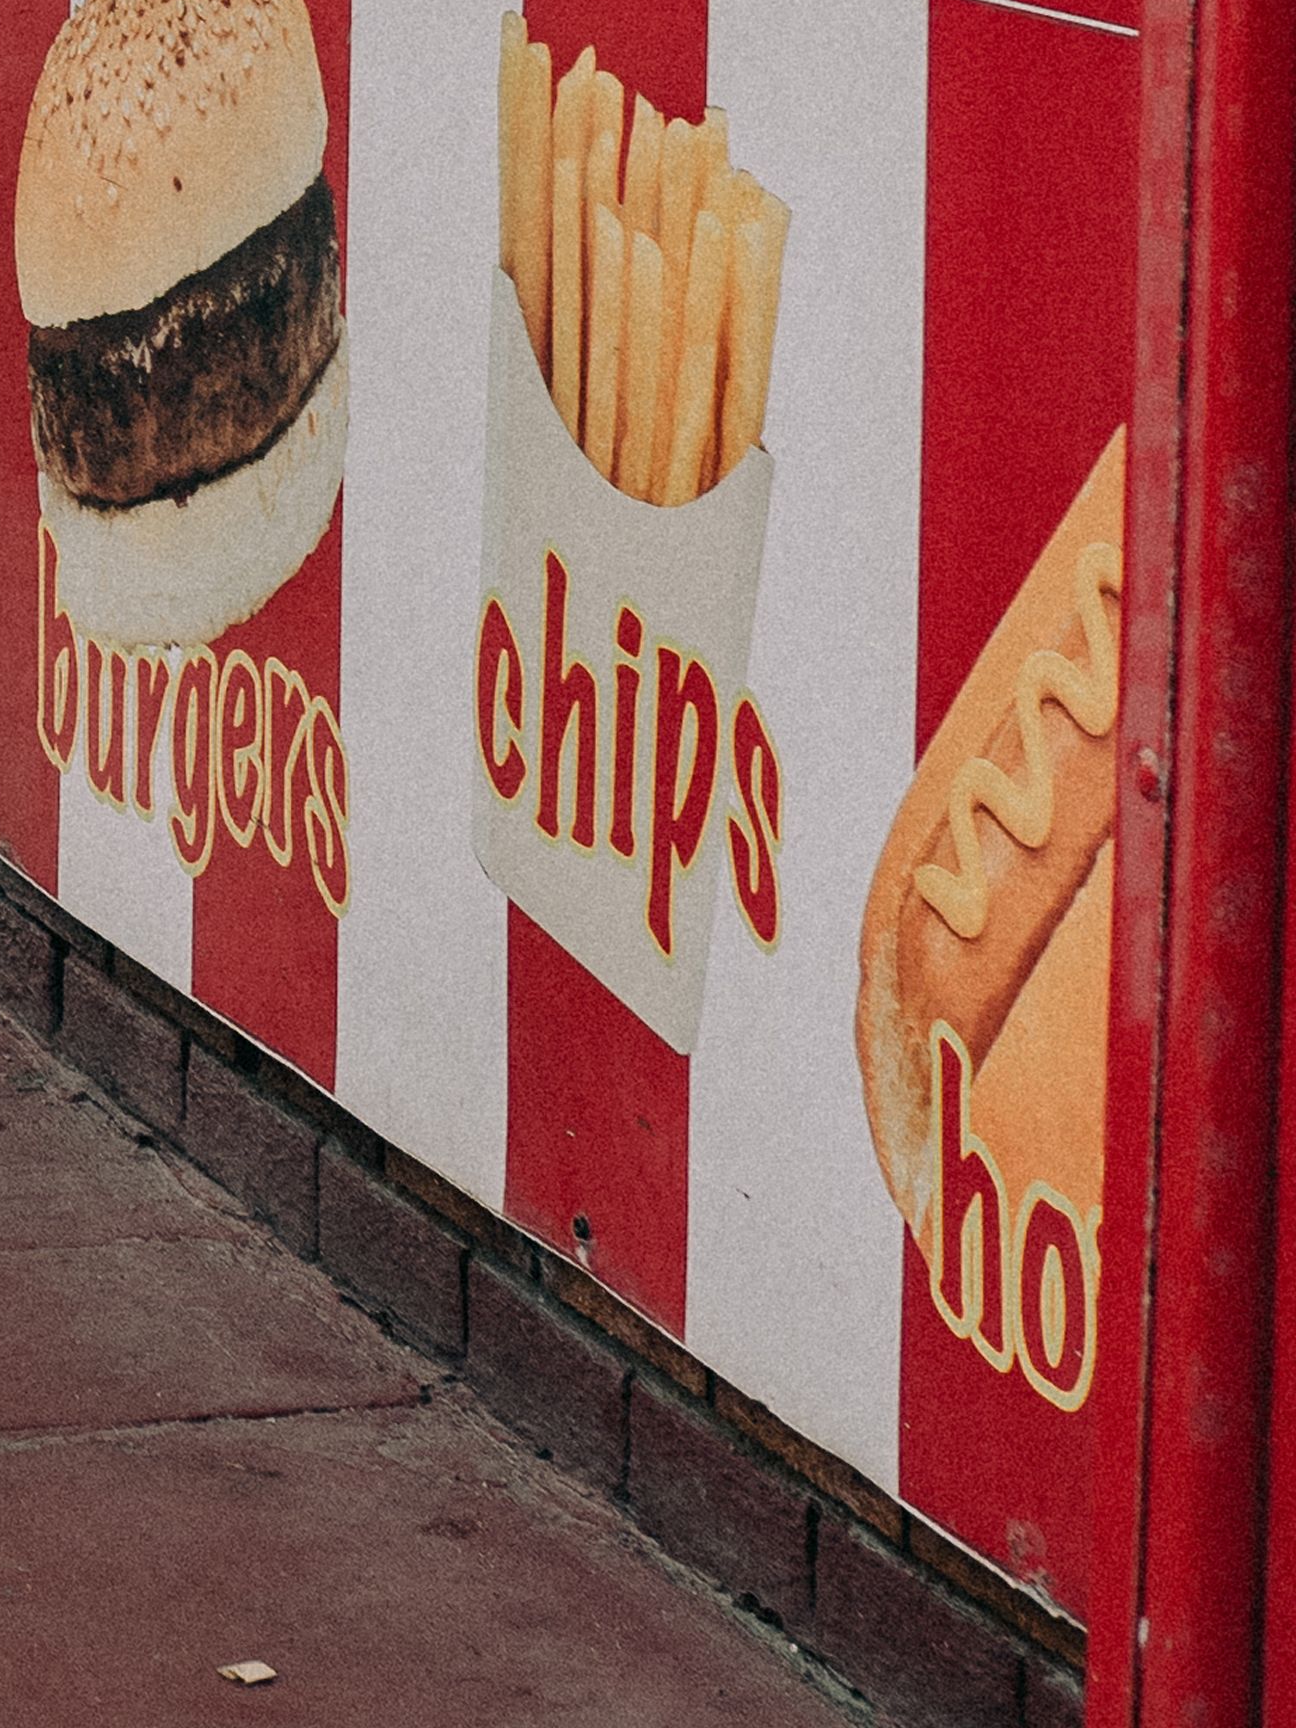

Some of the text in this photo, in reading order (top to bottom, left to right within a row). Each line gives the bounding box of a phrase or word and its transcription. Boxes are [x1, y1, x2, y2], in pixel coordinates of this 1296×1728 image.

[36, 519, 353, 922] burgers
[473, 545, 786, 962] chips
[926, 1018, 1103, 1413] ho
